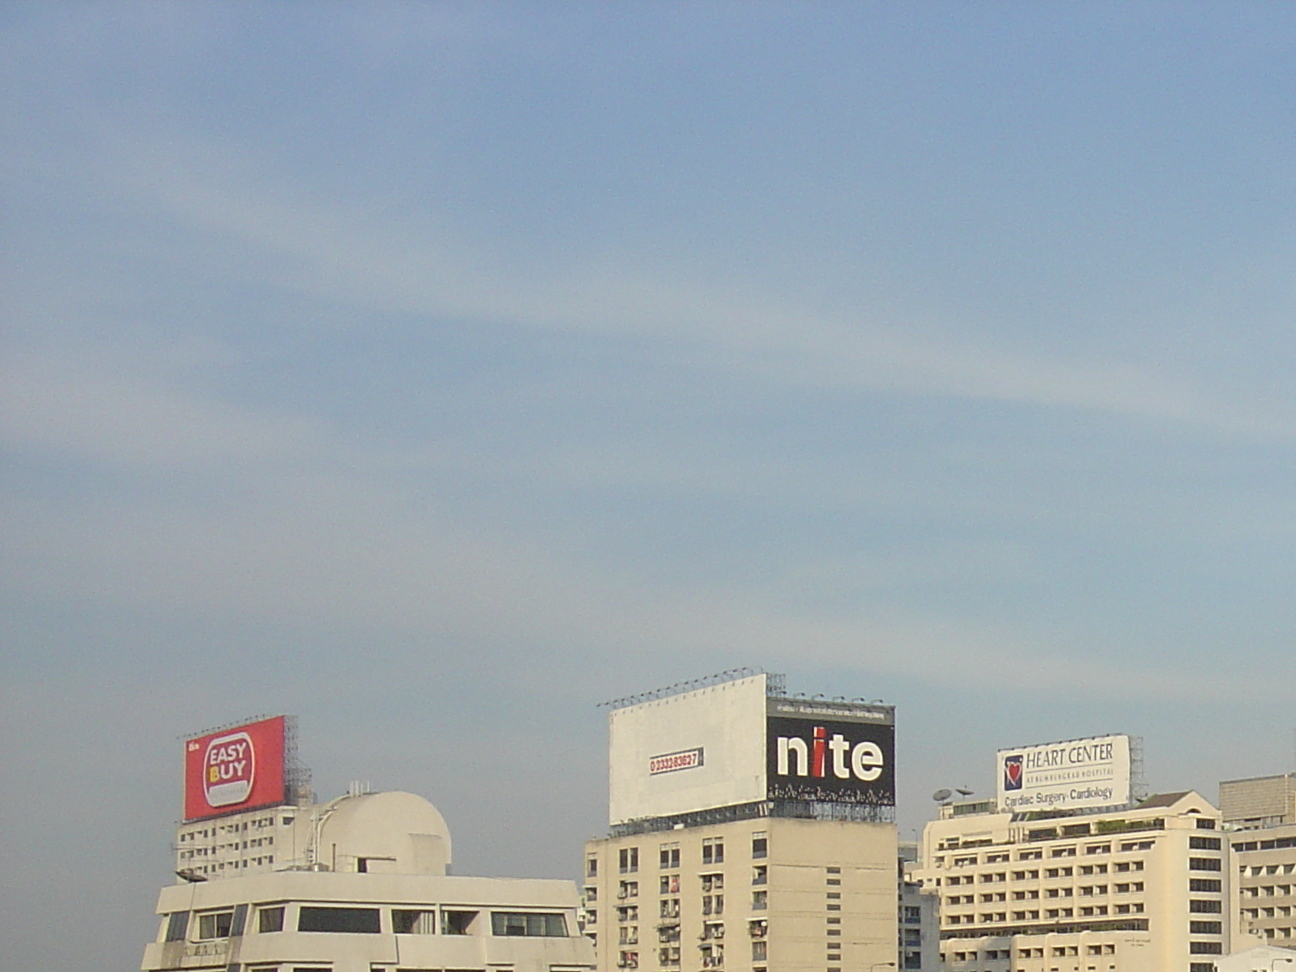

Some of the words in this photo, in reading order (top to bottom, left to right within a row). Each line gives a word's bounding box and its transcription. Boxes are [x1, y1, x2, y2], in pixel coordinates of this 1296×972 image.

[210, 742, 246, 765] EASY
[777, 726, 884, 781] nite
[1026, 749, 1066, 769] HEART
[1068, 743, 1113, 764] CENTER
[210, 760, 246, 782] BUY
[1005, 794, 1034, 807] Cardiac
[1070, 786, 1113, 801] Cardiology
